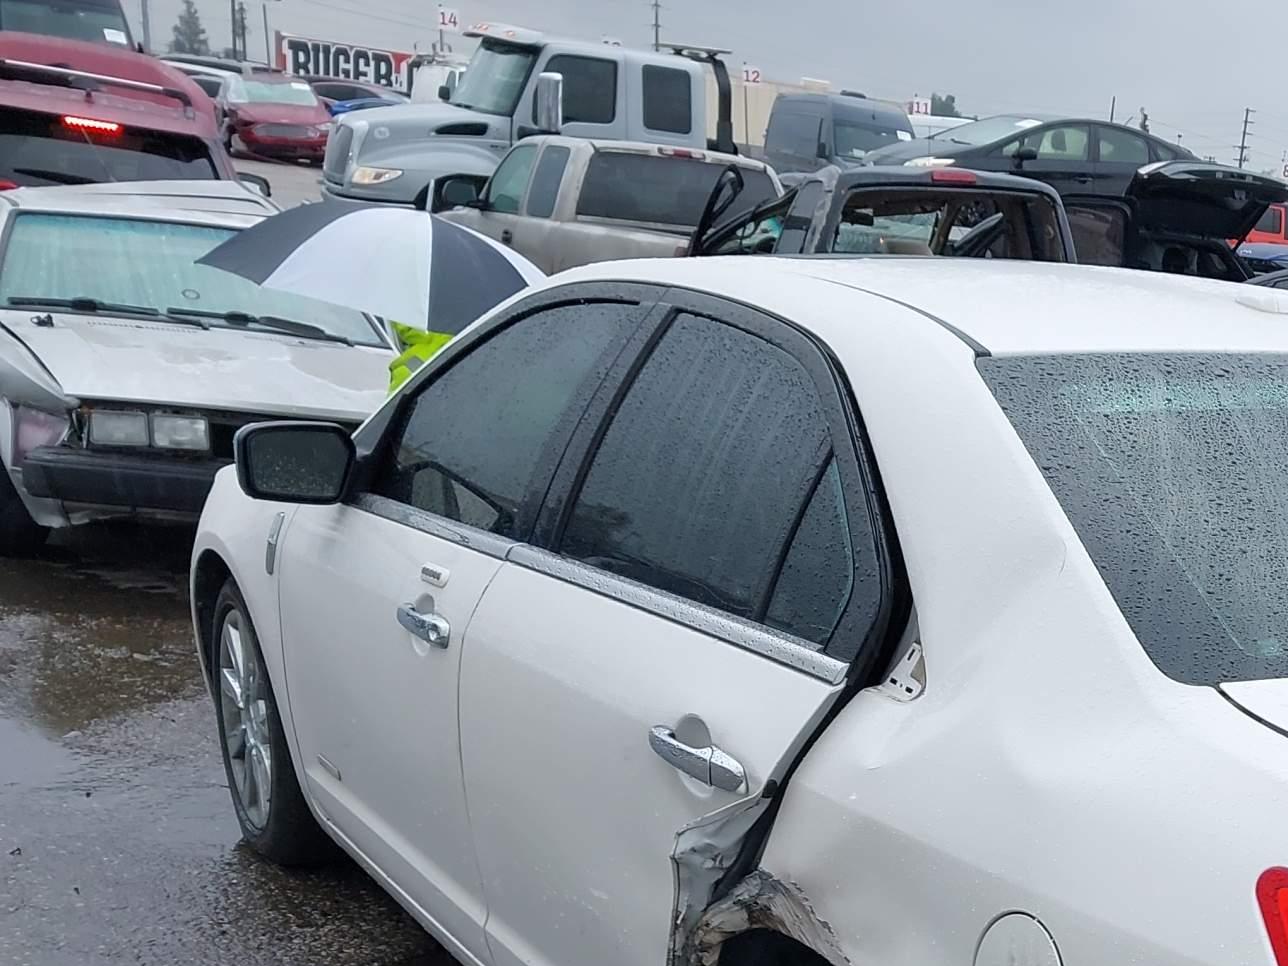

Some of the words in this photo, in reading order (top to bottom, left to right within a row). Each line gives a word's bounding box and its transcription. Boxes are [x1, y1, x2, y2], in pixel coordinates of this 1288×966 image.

[440, 11, 458, 28] 14
[744, 70, 760, 83] 12
[915, 101, 929, 115] 11
